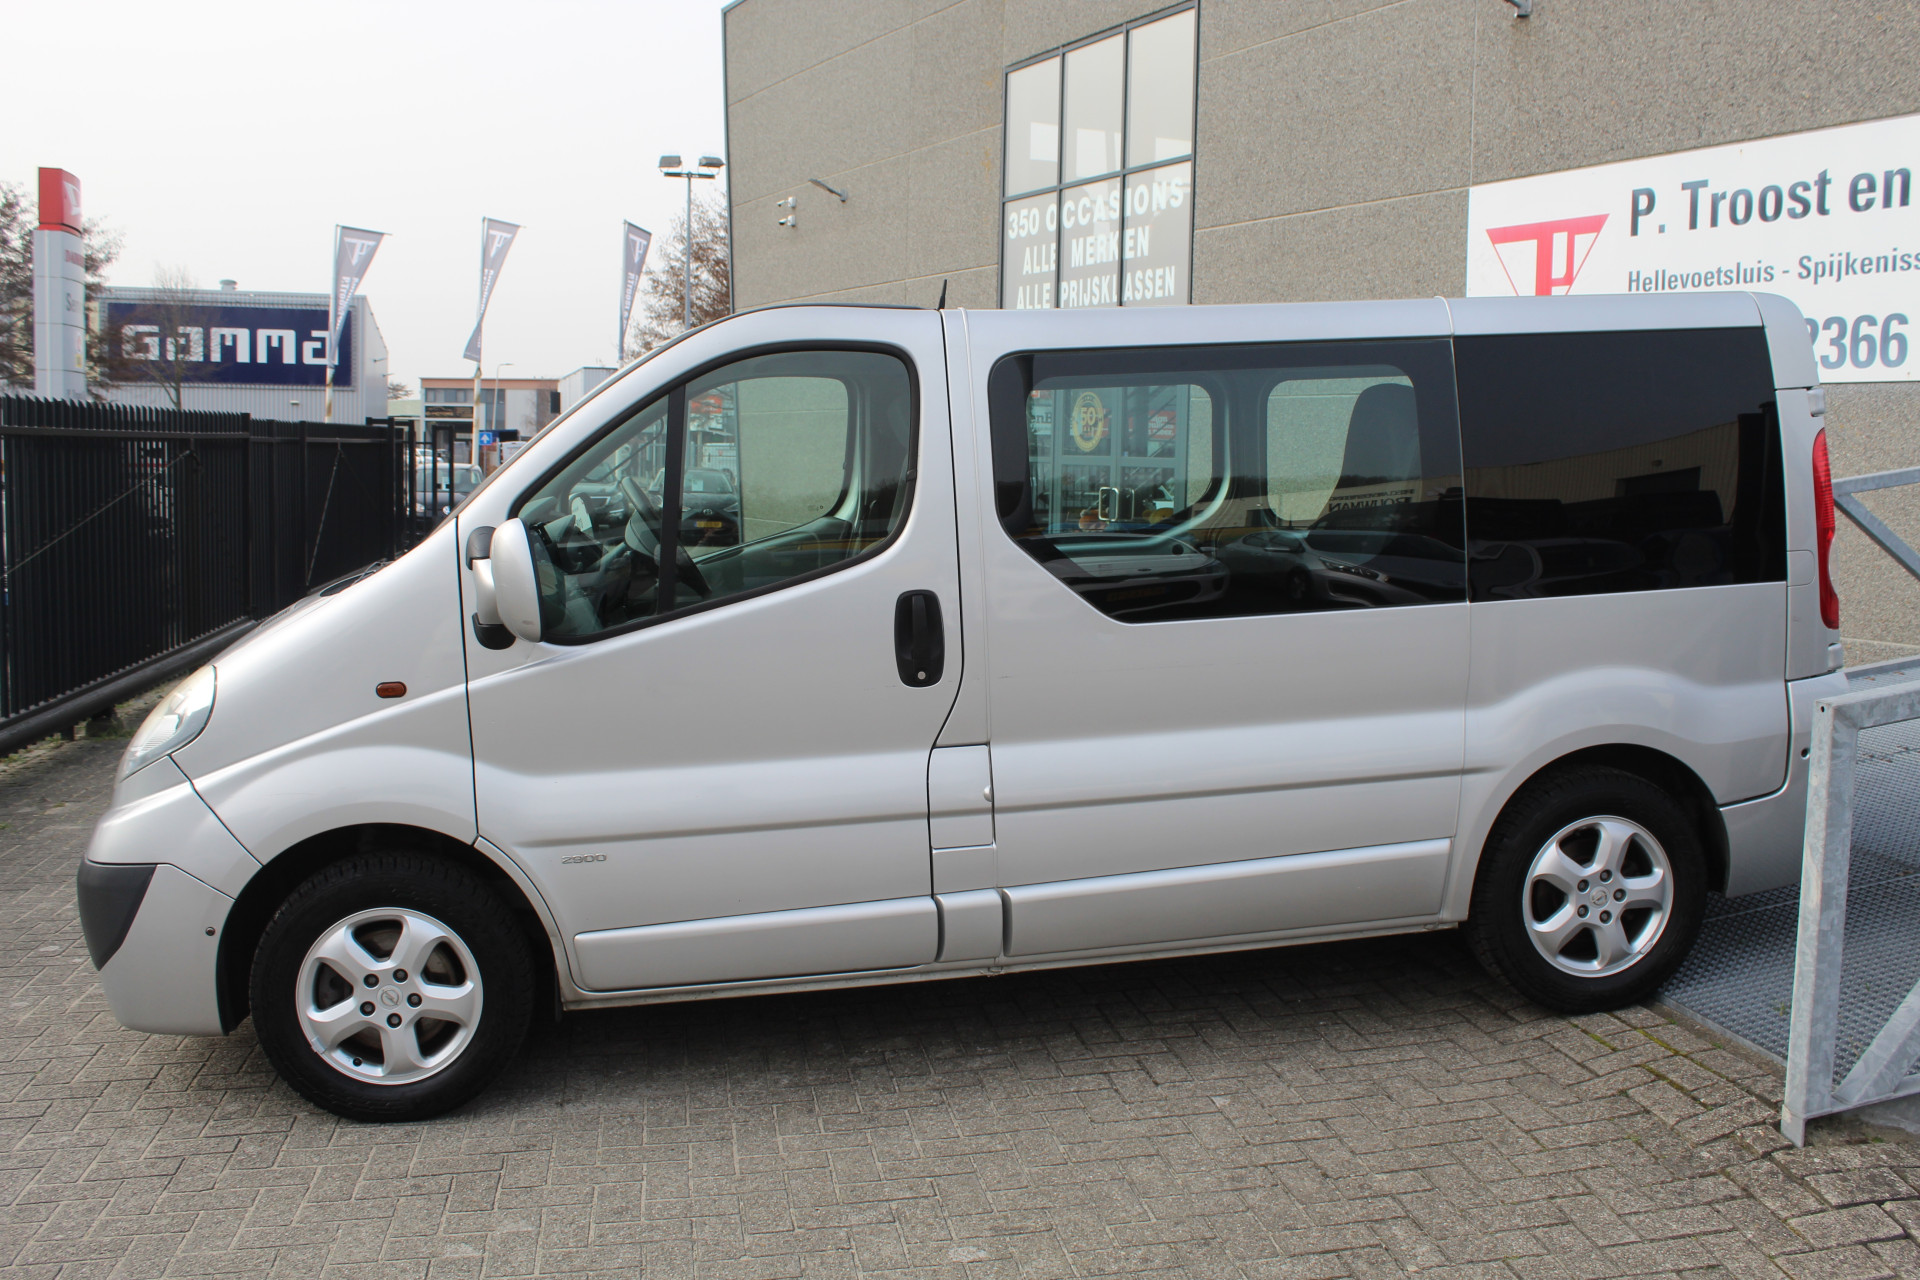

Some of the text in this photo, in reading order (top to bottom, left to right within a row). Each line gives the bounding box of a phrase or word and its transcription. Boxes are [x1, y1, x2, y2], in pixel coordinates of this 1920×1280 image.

[1008, 179, 1184, 240] 350 OCCASIONS
[1630, 167, 1912, 237] P. Troost en
[1023, 226, 1150, 275] ALLE MERKEN
[1016, 266, 1176, 309] ALLE PRIJSKLASSEN
[1628, 260, 1775, 292] Hellevoetsluis
